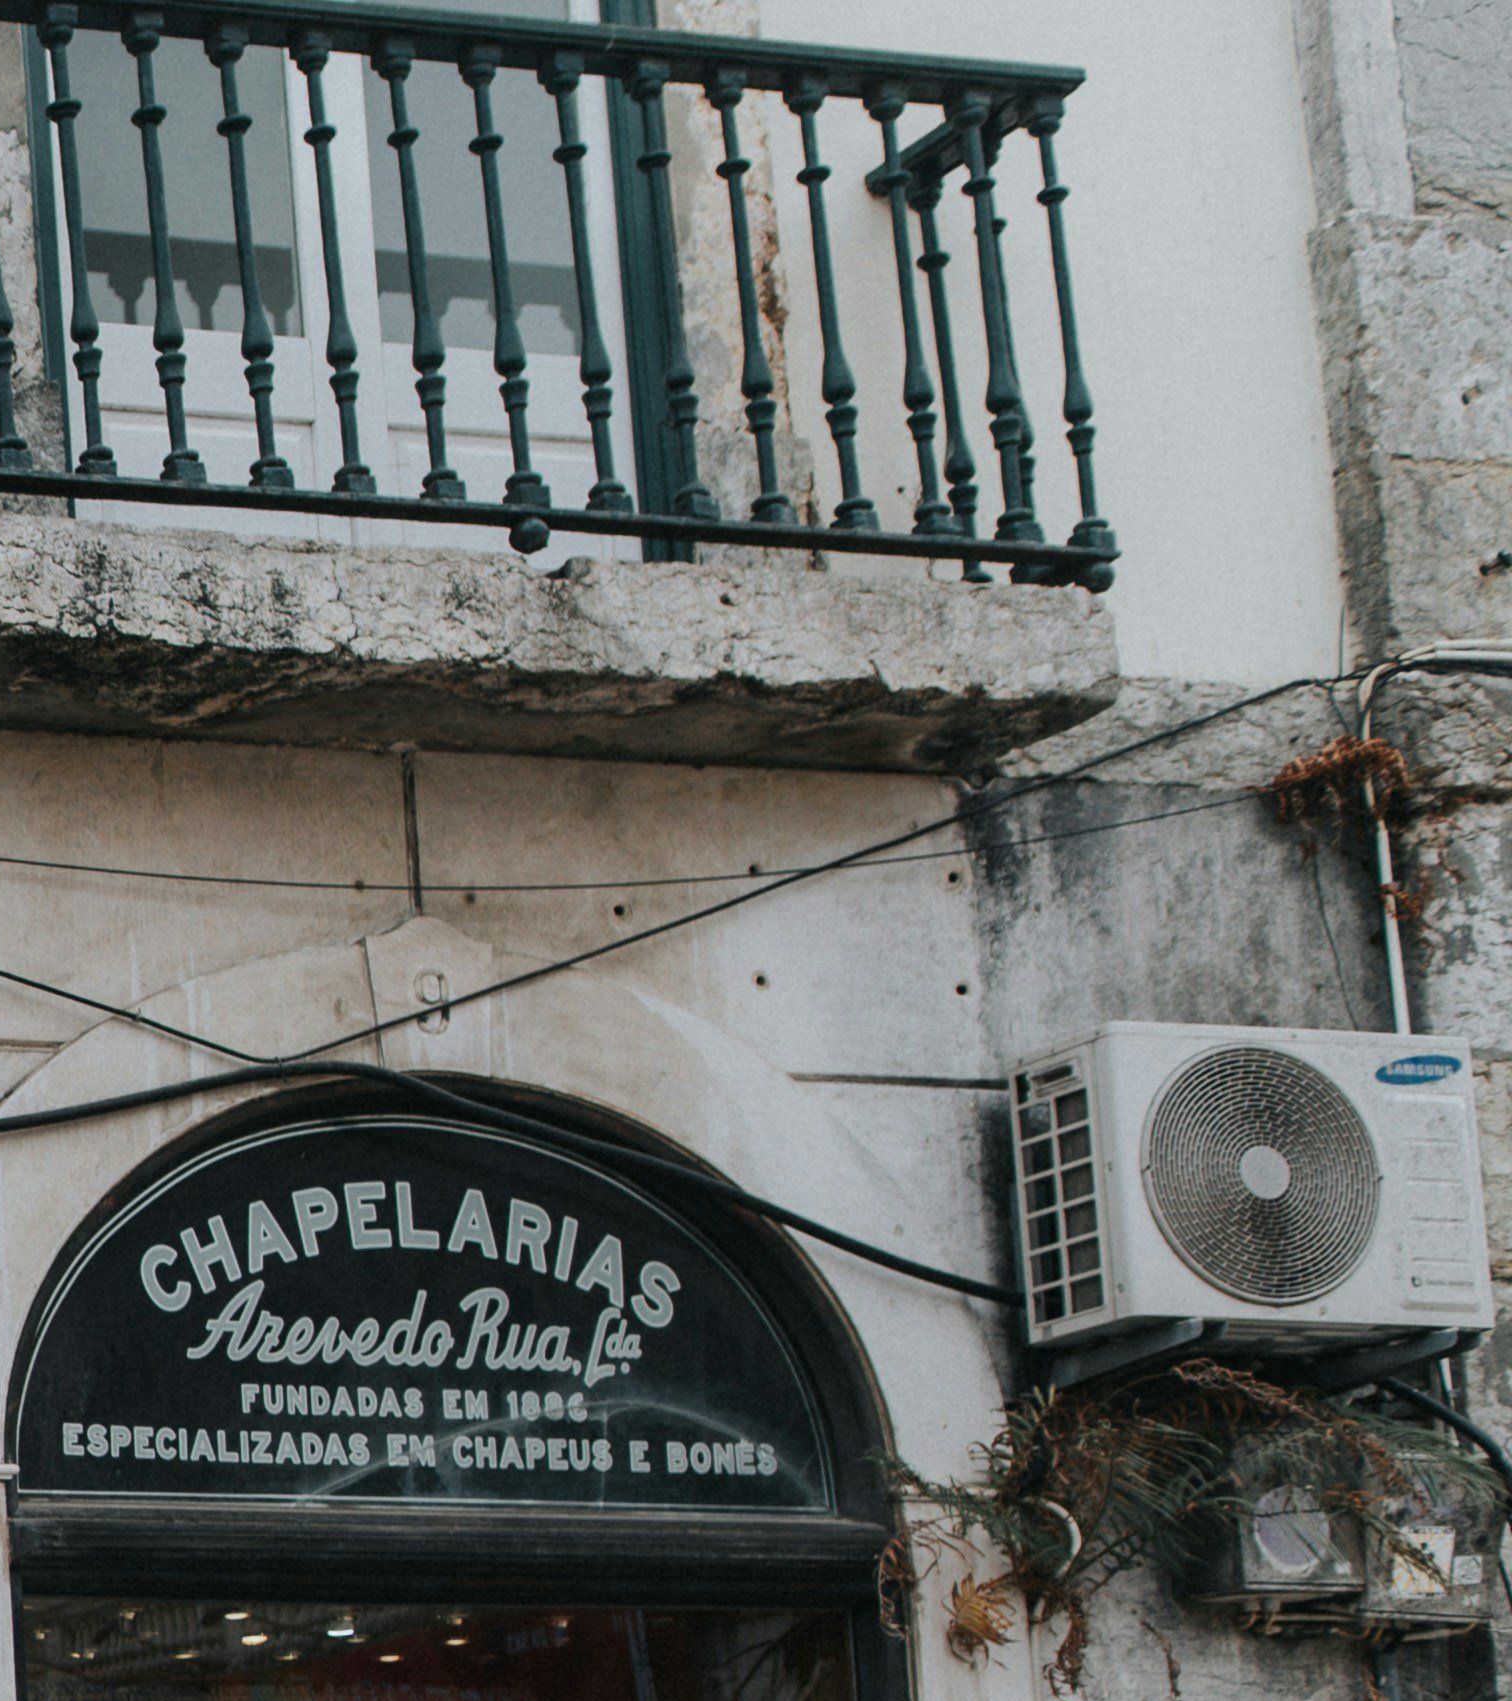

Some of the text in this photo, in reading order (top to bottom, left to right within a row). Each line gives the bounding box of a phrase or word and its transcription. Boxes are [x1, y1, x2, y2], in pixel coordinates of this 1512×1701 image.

[1385, 1062, 1455, 1077] SAMSUNG
[139, 1181, 682, 1328] CHAPELARIAS
[186, 1279, 455, 1362] Azevedo
[456, 1287, 583, 1377] Rua,
[240, 1384, 589, 1424] FUNDADAS EM 1886
[62, 1422, 778, 1476] ESPECIALIZADAS EM CHAPEUS E BONÉS
